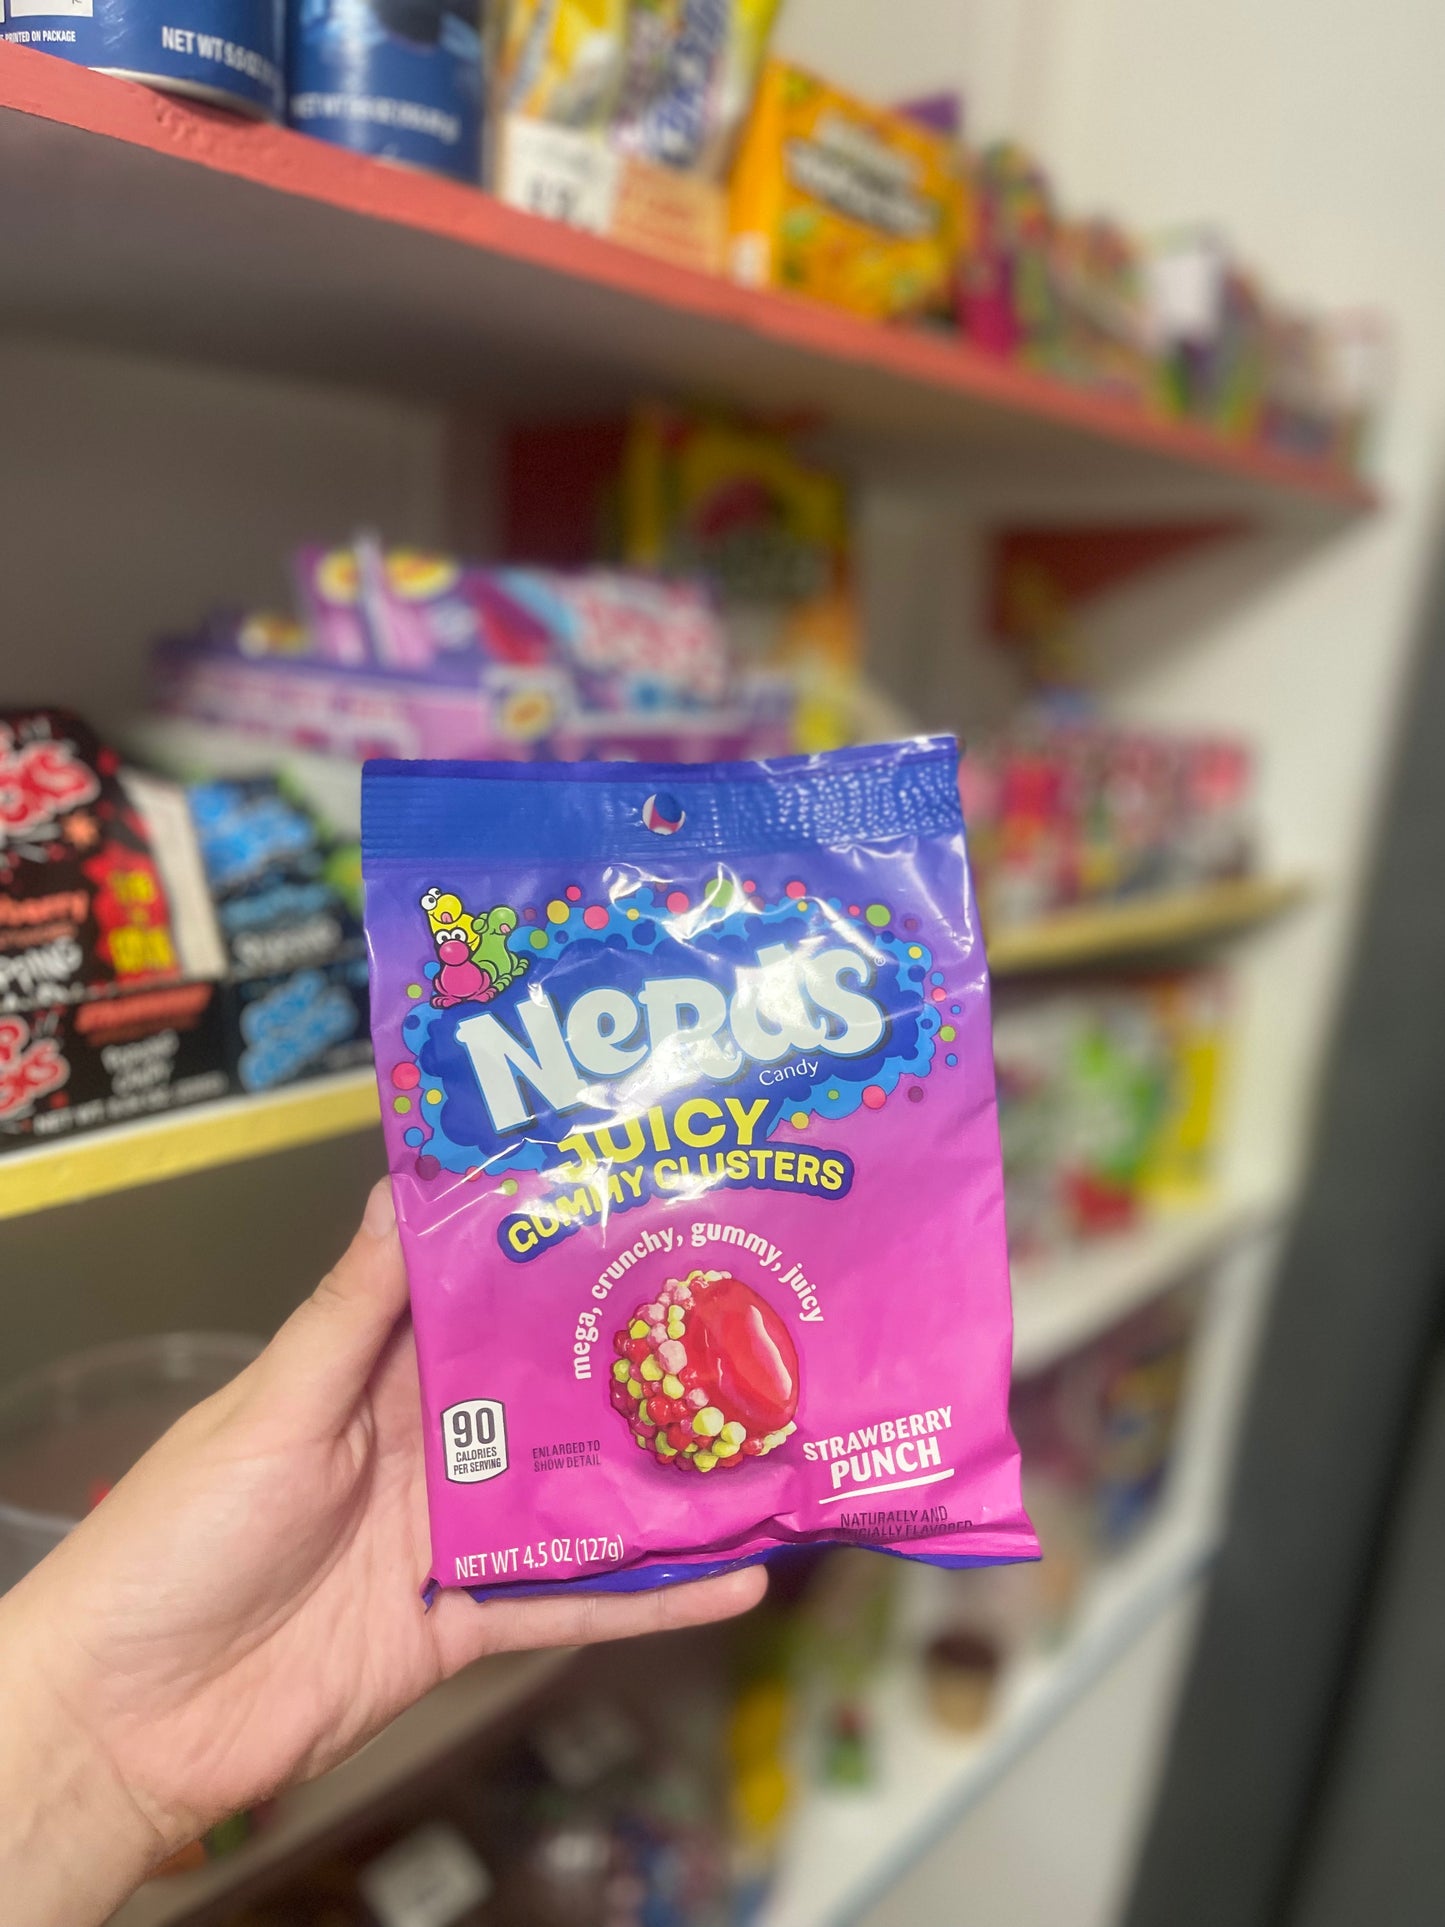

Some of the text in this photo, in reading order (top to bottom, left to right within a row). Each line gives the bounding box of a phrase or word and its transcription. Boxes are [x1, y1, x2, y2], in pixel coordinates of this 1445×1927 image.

[31, 30, 41, 42] ON
[42, 30, 76, 42] PACKAGE
[162, 25, 195, 54] NET
[196, 33, 224, 62] WT
[758, 1058, 819, 1086] Candy
[557, 1098, 769, 1184] JUICY
[508, 1149, 845, 1253] GUMMY CLUSTERS
[573, 1222, 825, 1380] mega, crunchy, gummy, juicy
[452, 1407, 496, 1448] 90
[802, 1405, 952, 1461] STRAWBERRY
[453, 1457, 501, 1475] PER SERVING
[456, 1446, 497, 1463] CALORIES
[532, 1439, 600, 1459] ENLARGED TO
[534, 1453, 601, 1473] SHOW DETAIL
[830, 1436, 942, 1489] PUNCH
[840, 1505, 948, 1528] NATURALLY AND
[455, 1534, 625, 1580] NET WT 4.5 OZ (127g)
